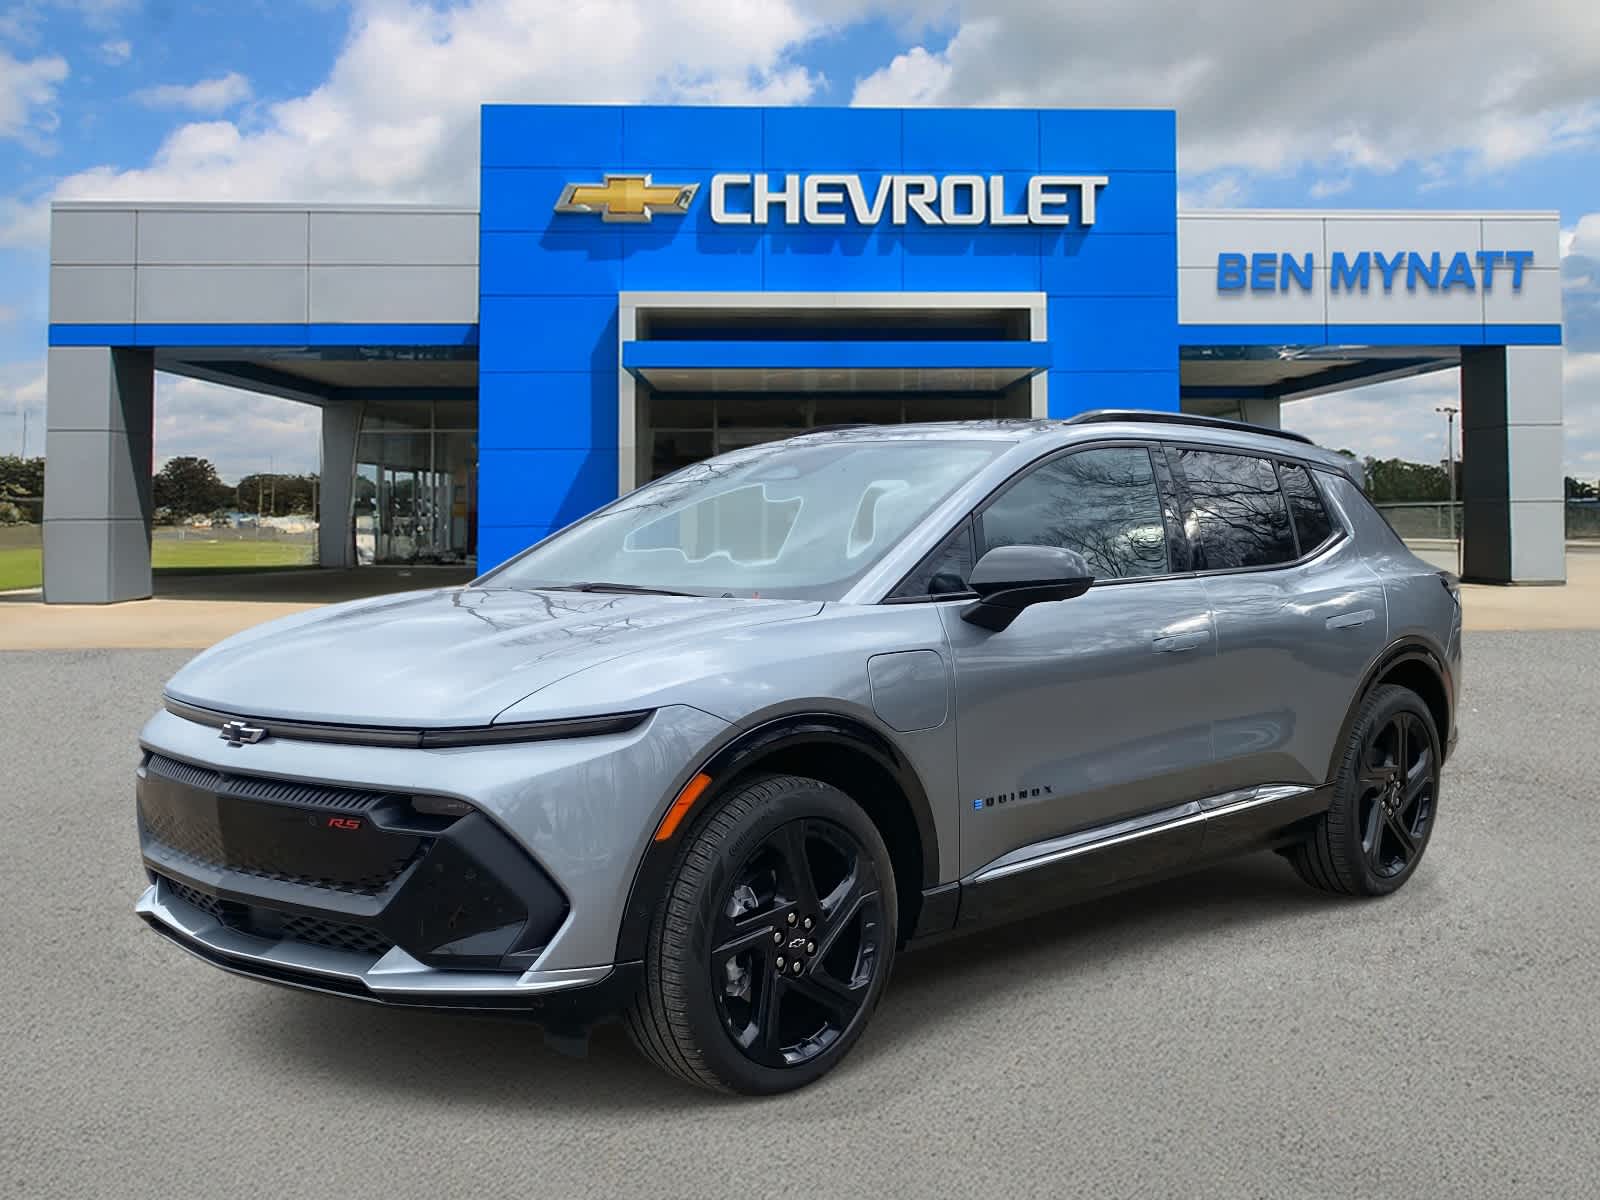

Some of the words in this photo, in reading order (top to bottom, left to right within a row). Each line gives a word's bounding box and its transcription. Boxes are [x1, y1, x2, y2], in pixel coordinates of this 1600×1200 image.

[710, 173, 1109, 226] CHEVROLET
[1217, 252, 1313, 290] BEN
[1330, 250, 1534, 290] MYNATT
[328, 817, 361, 830] RS
